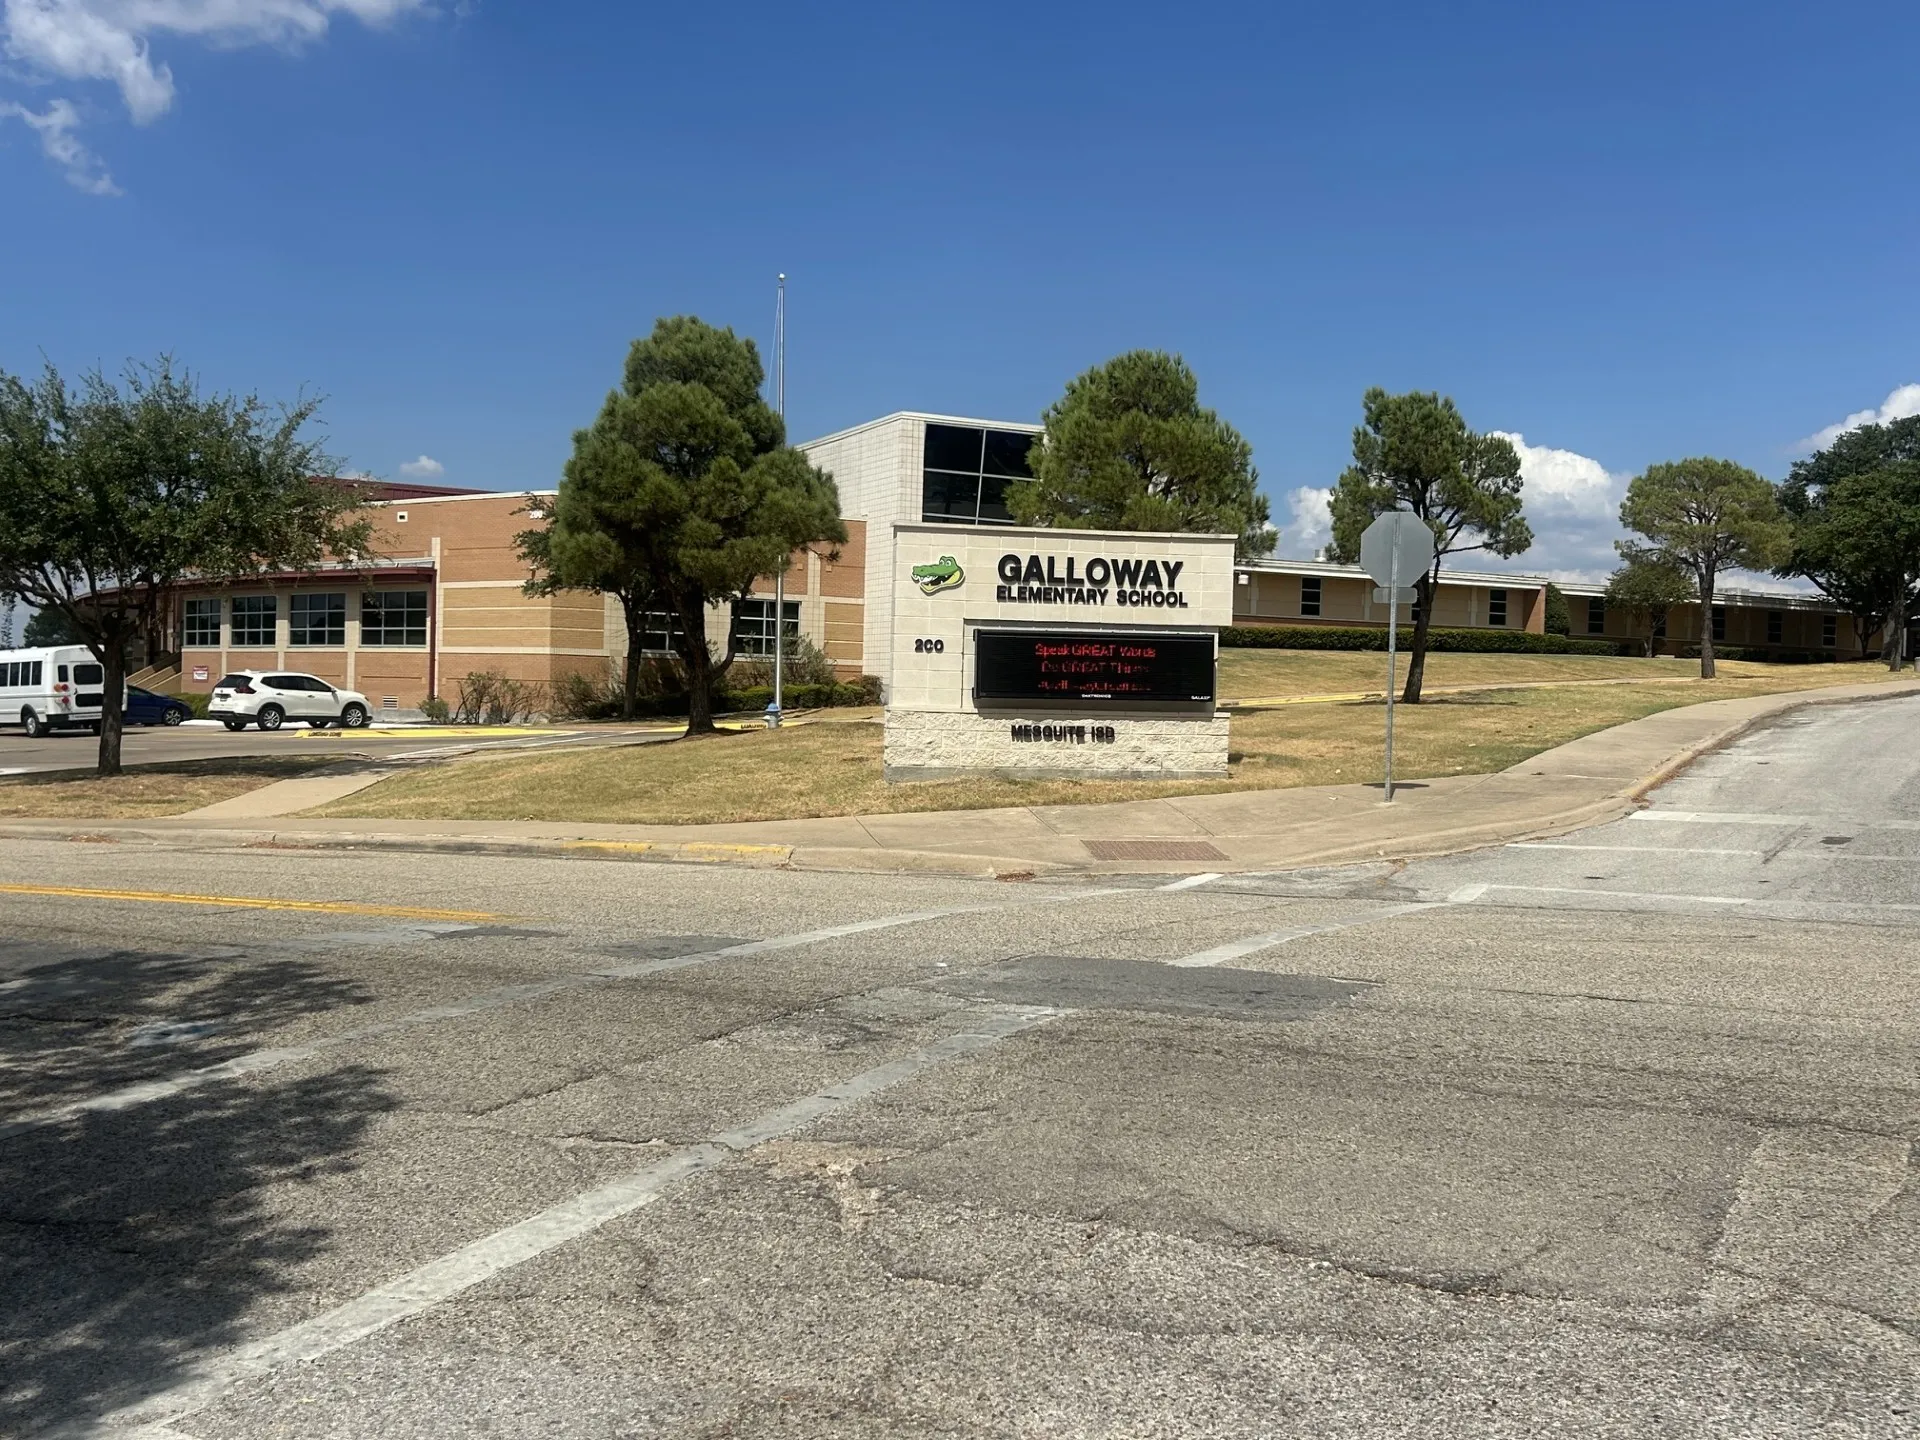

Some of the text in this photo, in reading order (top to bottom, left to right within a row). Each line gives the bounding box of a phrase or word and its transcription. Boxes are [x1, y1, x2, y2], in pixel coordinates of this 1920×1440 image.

[997, 554, 1184, 590] GALLOWAY
[996, 585, 1188, 608] ELEMENTARY SCHOOL
[914, 638, 945, 654] 200
[1035, 643, 1070, 658] Speak
[1072, 644, 1116, 657] GREAT
[1011, 725, 1116, 744] MESQUITE ISD
